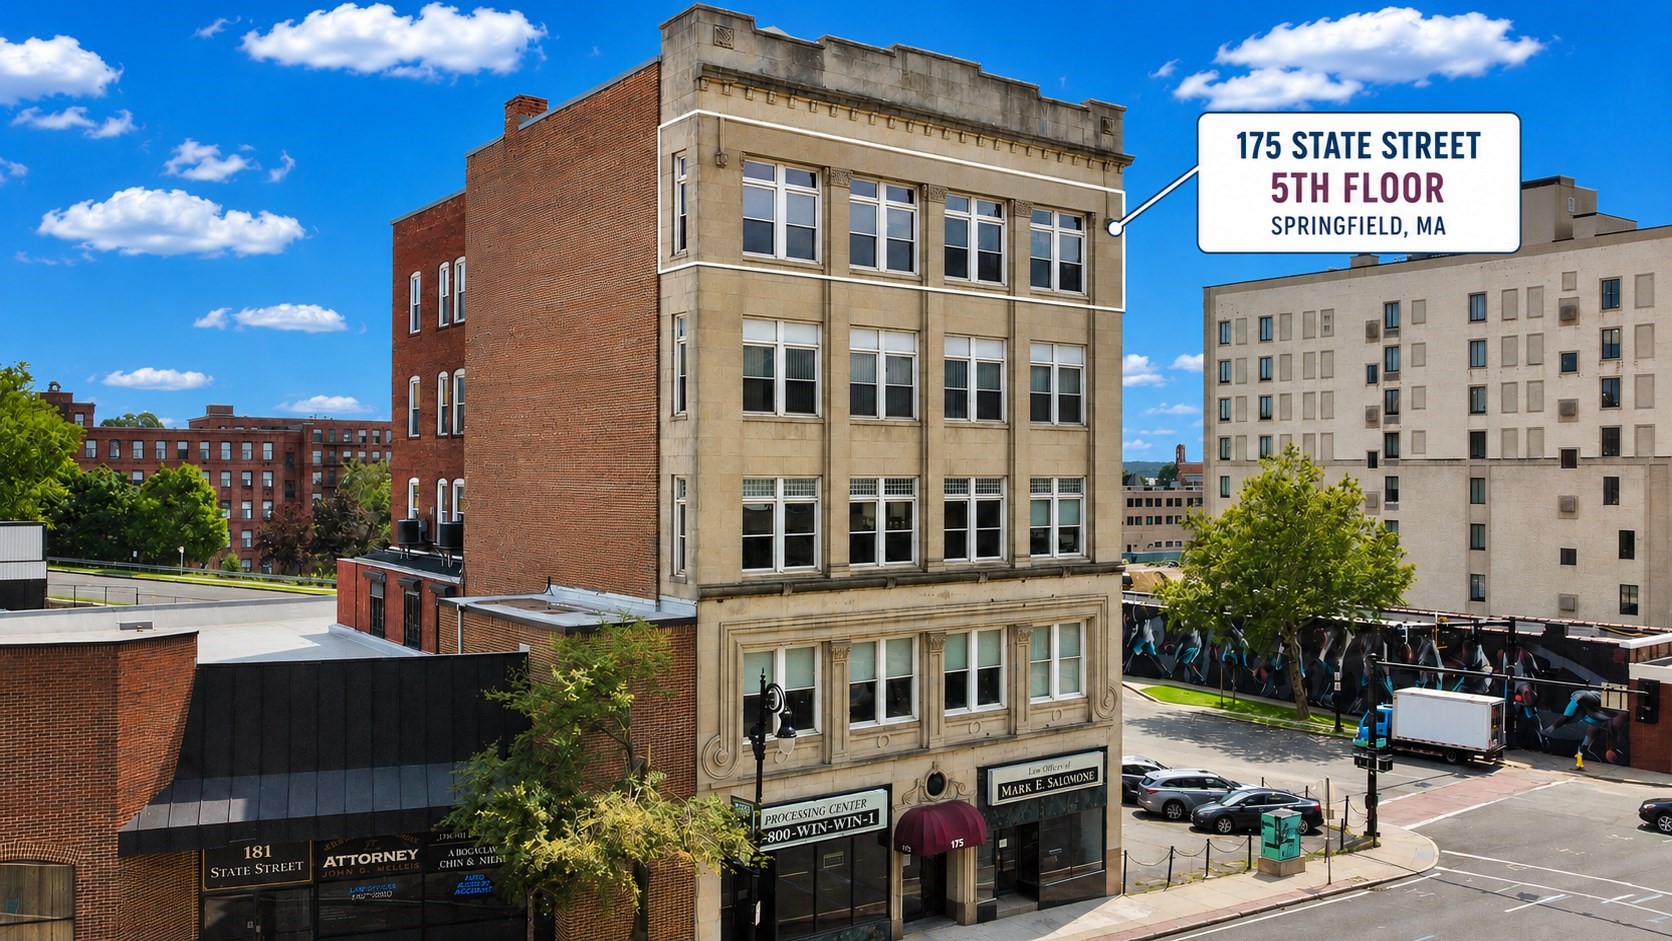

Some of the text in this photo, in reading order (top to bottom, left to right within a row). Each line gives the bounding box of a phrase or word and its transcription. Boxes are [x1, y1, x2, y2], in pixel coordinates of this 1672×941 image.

[1001, 770, 1095, 797] MARK E. SALOMONE
[764, 805, 826, 826] PROCESSING
[829, 798, 868, 814] CENTER
[760, 812, 875, 844] -800-WIN-WIN-1
[244, 844, 272, 859] 181
[950, 838, 964, 849] 175
[322, 848, 419, 869] ATTORNEY
[466, 857, 475, 866] &
[210, 861, 304, 879] STATE STREET
[322, 868, 353, 878] JOHN
